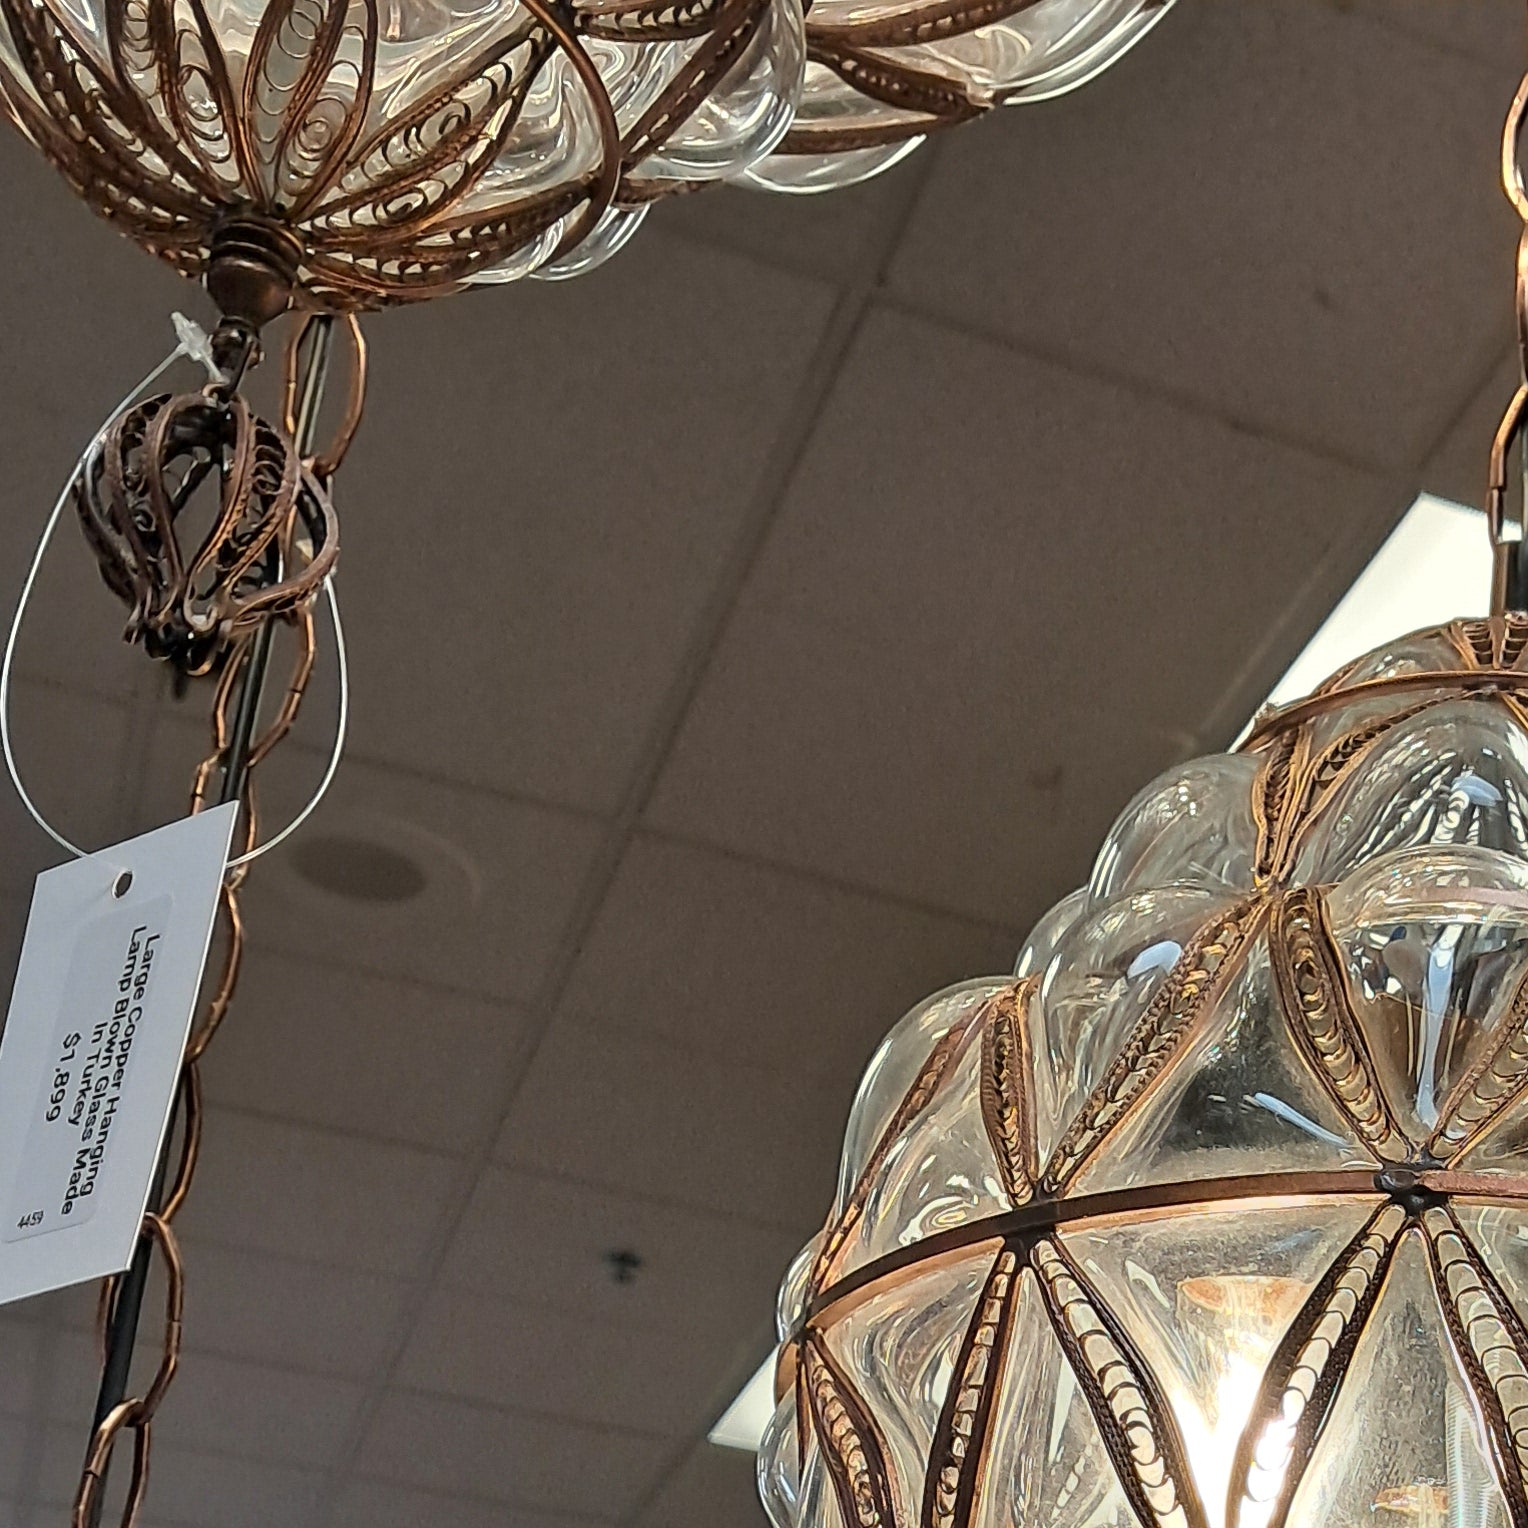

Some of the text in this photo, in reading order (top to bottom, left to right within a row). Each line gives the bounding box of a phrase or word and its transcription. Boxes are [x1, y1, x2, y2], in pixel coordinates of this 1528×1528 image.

[45, 1032, 82, 1122] $1,899
[61, 925, 148, 1215] Lamp Blown Glass Made
[67, 1021, 109, 1126] In Turkey
[77, 934, 161, 1197] Large Copper Hanging
